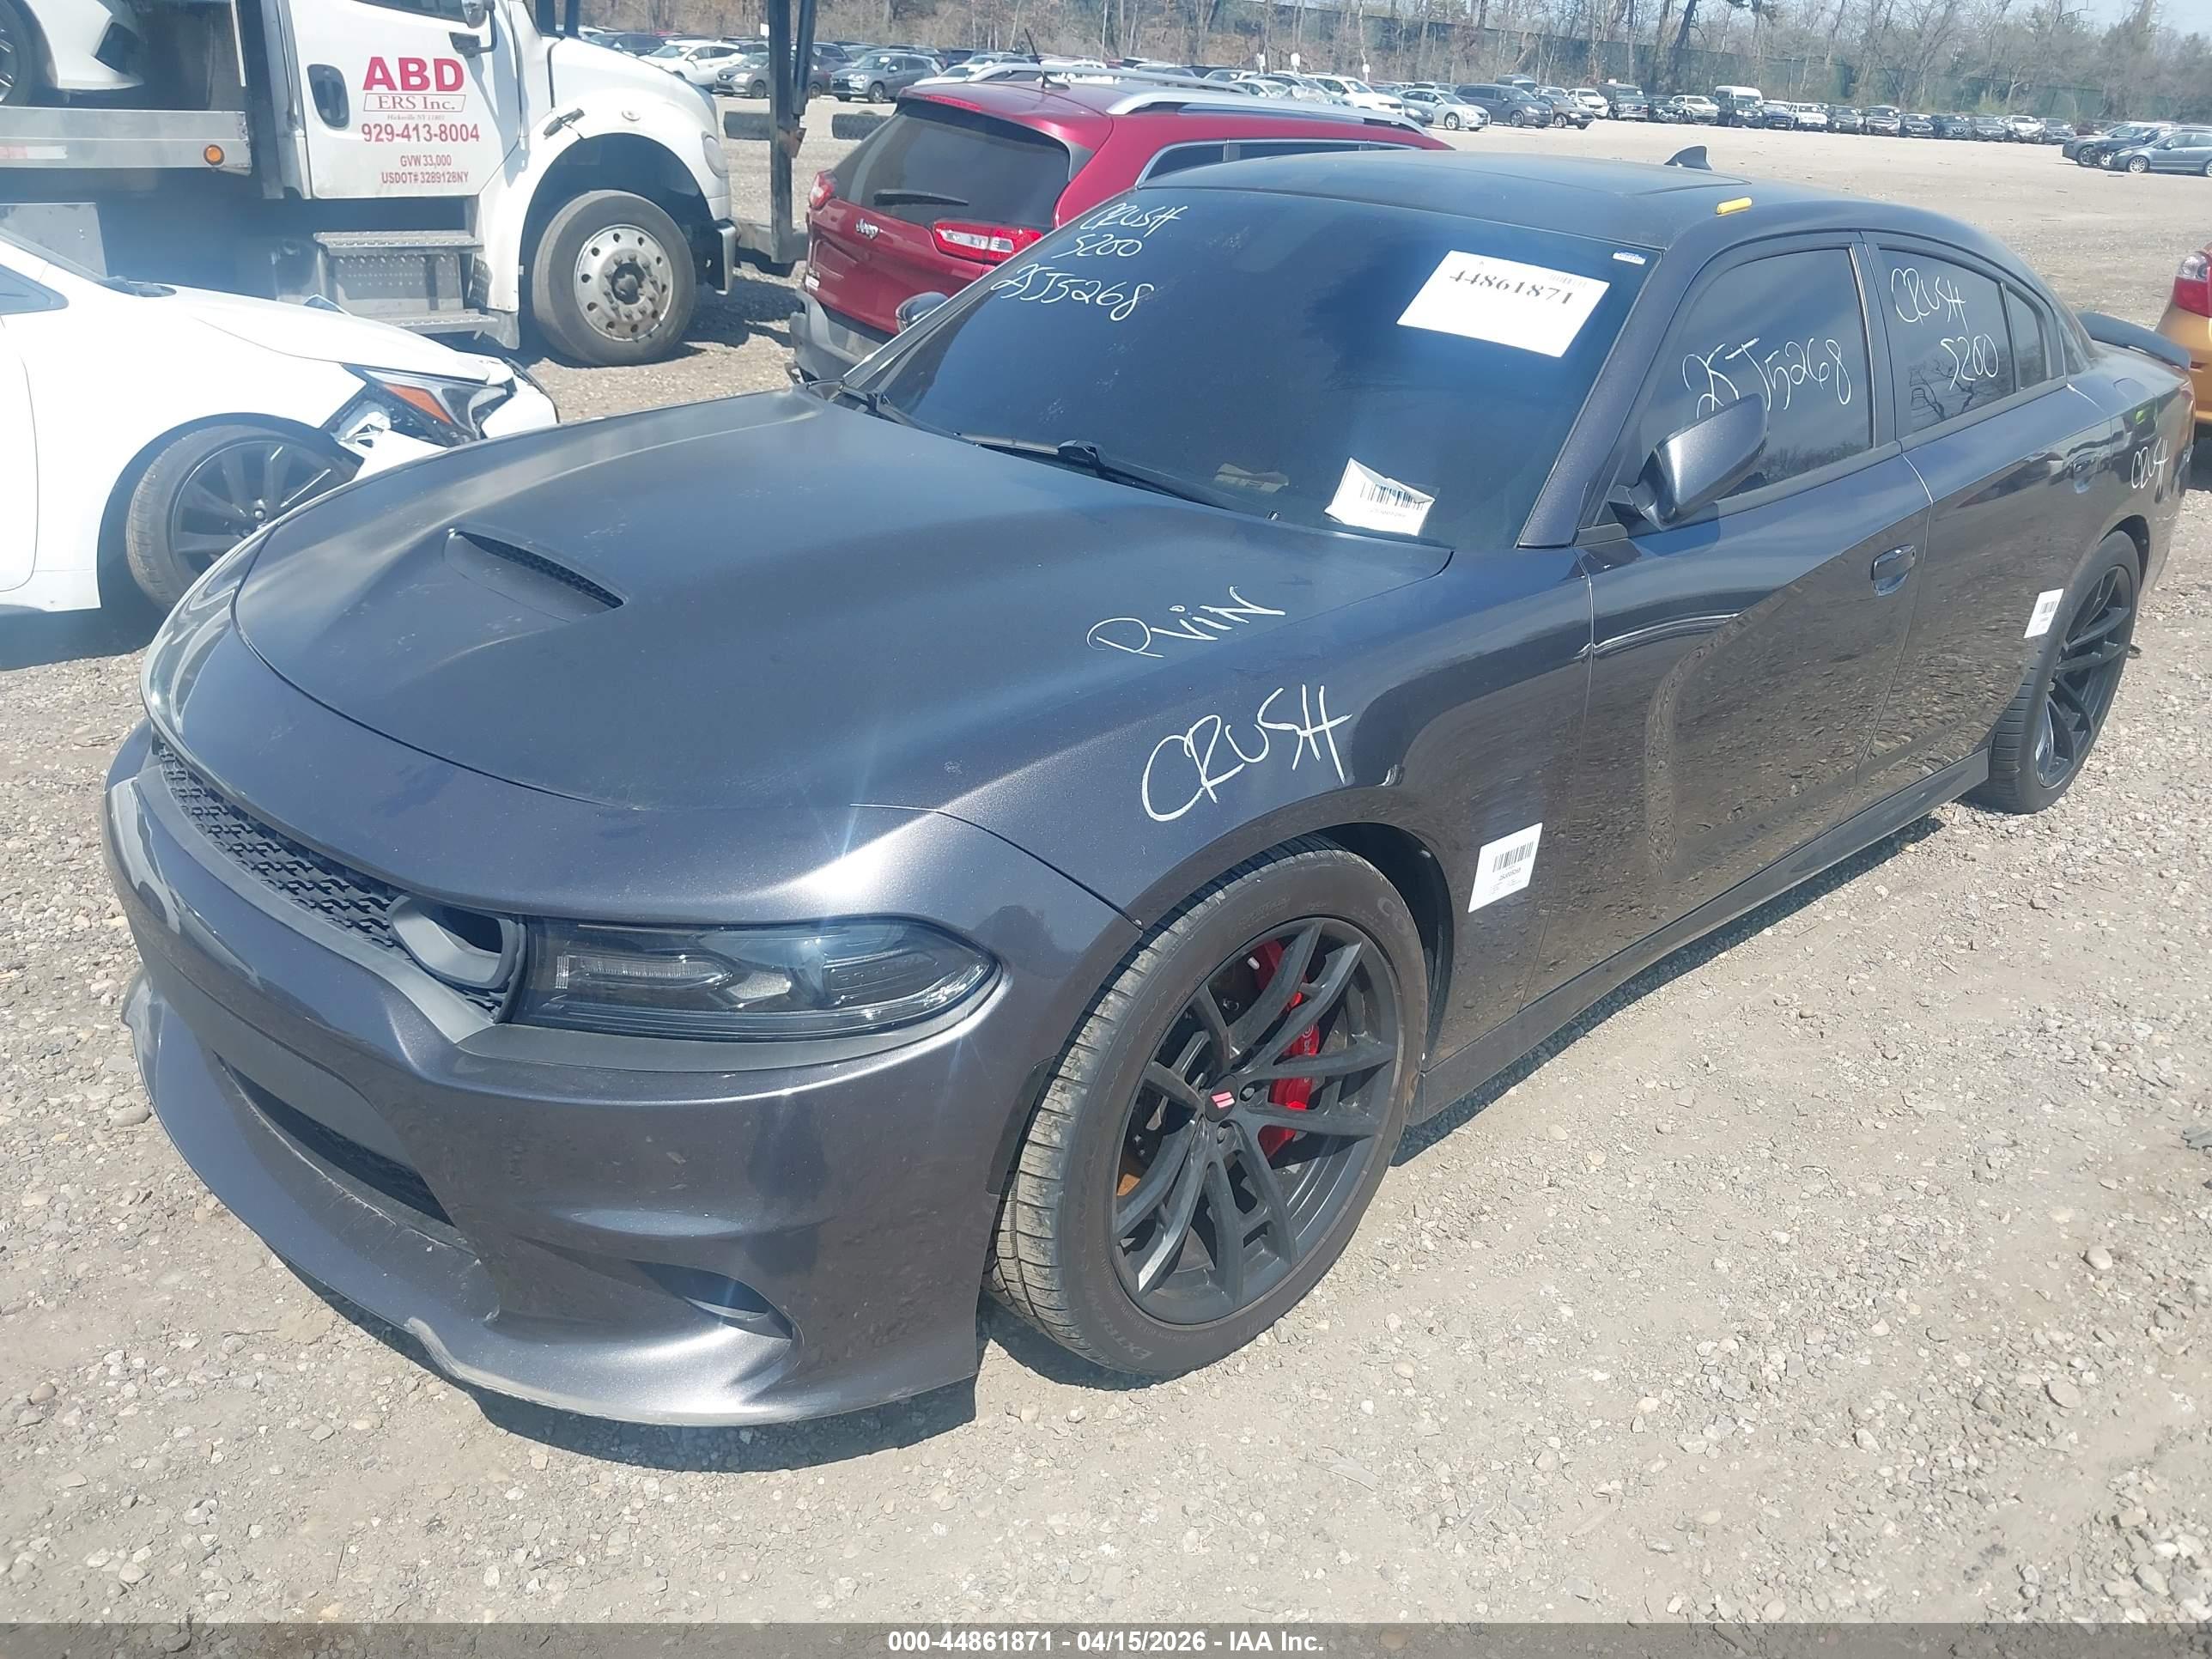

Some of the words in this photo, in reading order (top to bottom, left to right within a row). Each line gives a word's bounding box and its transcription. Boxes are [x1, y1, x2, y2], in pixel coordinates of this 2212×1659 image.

[362, 57, 465, 92] ABD
[378, 95, 416, 110] ERS
[422, 96, 456, 110] Inc.
[362, 123, 480, 143] 929-413-8004
[381, 172, 418, 184] USDOT#
[400, 155, 421, 167] GVW
[423, 155, 452, 168] 33,000
[1079, 202, 1188, 238] CRUSH
[1051, 234, 1143, 258] 5200
[1449, 269, 1574, 304] 44861871
[1891, 268, 1969, 333] CRUSH
[1940, 333, 1999, 390] 5200
[1142, 684, 1353, 823] CRUSH
